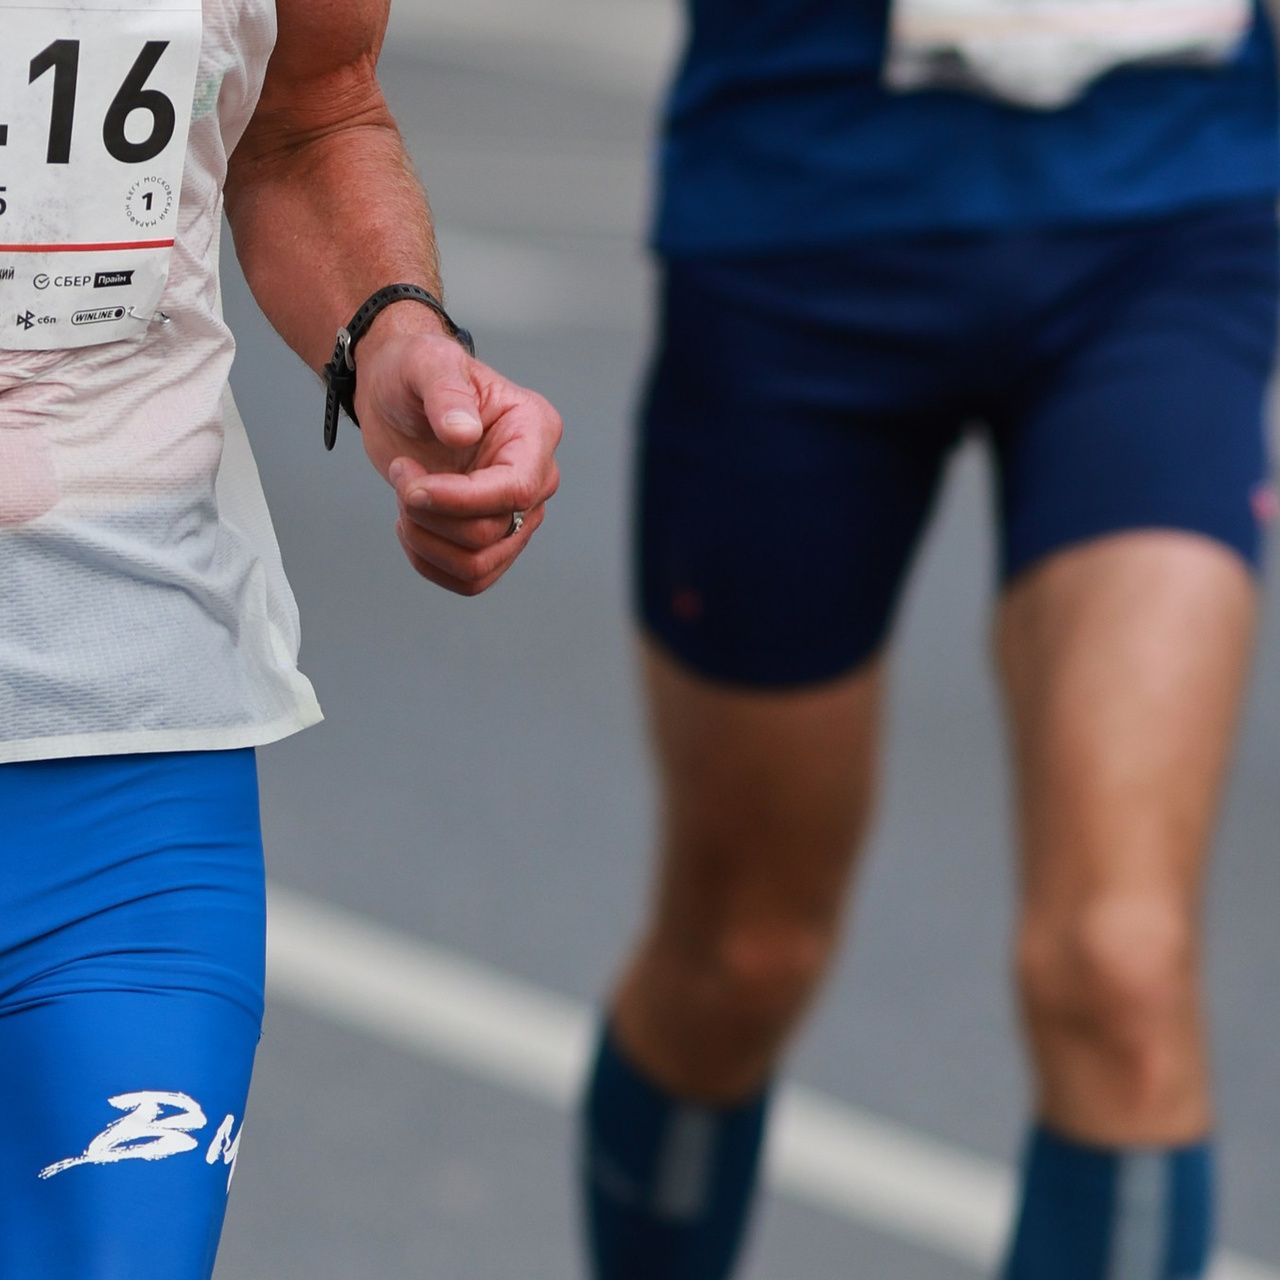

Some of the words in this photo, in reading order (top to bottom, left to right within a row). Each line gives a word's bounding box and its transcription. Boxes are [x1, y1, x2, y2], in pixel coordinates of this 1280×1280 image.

[141, 192, 153, 211] 1
[53, 275, 92, 288] СБЕР
[98, 274, 127, 285] Прайм
[75, 310, 114, 322] WINLINE
